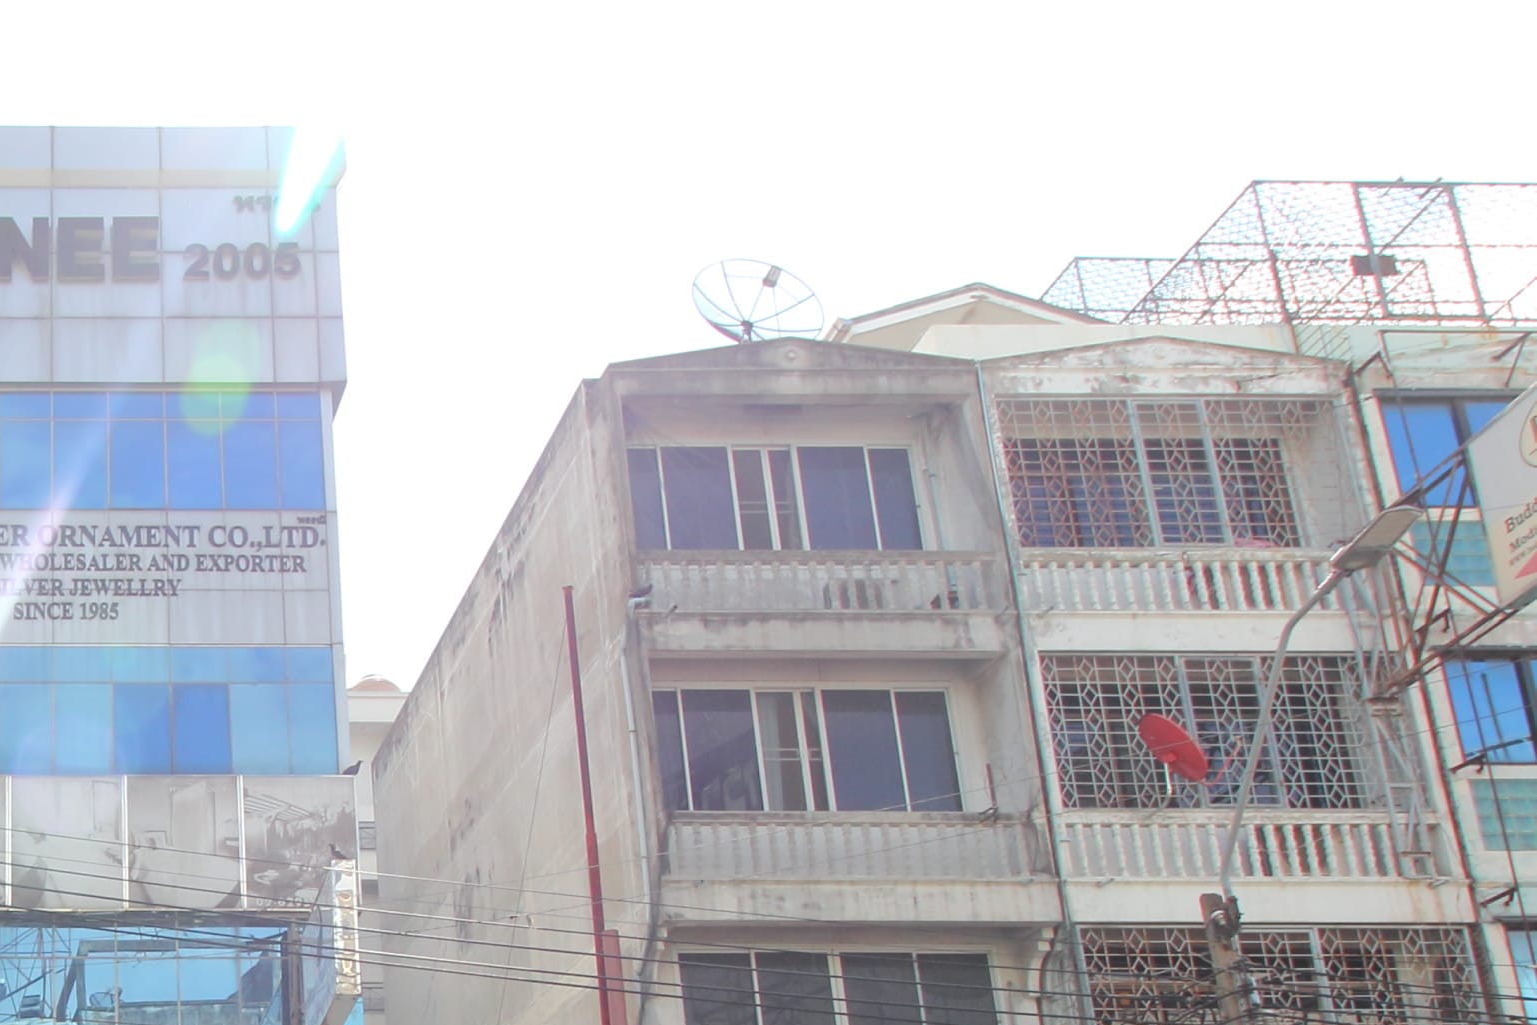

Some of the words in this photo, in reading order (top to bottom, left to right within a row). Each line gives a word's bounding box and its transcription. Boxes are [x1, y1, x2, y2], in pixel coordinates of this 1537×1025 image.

[182, 241, 303, 281] 2005
[37, 523, 201, 549] ORNAMENT
[146, 554, 191, 573] AND
[194, 554, 308, 573] EXPORTER
[68, 578, 183, 597] JEWELLRY
[12, 602, 74, 621] SINCE
[79, 602, 120, 621] 1985
